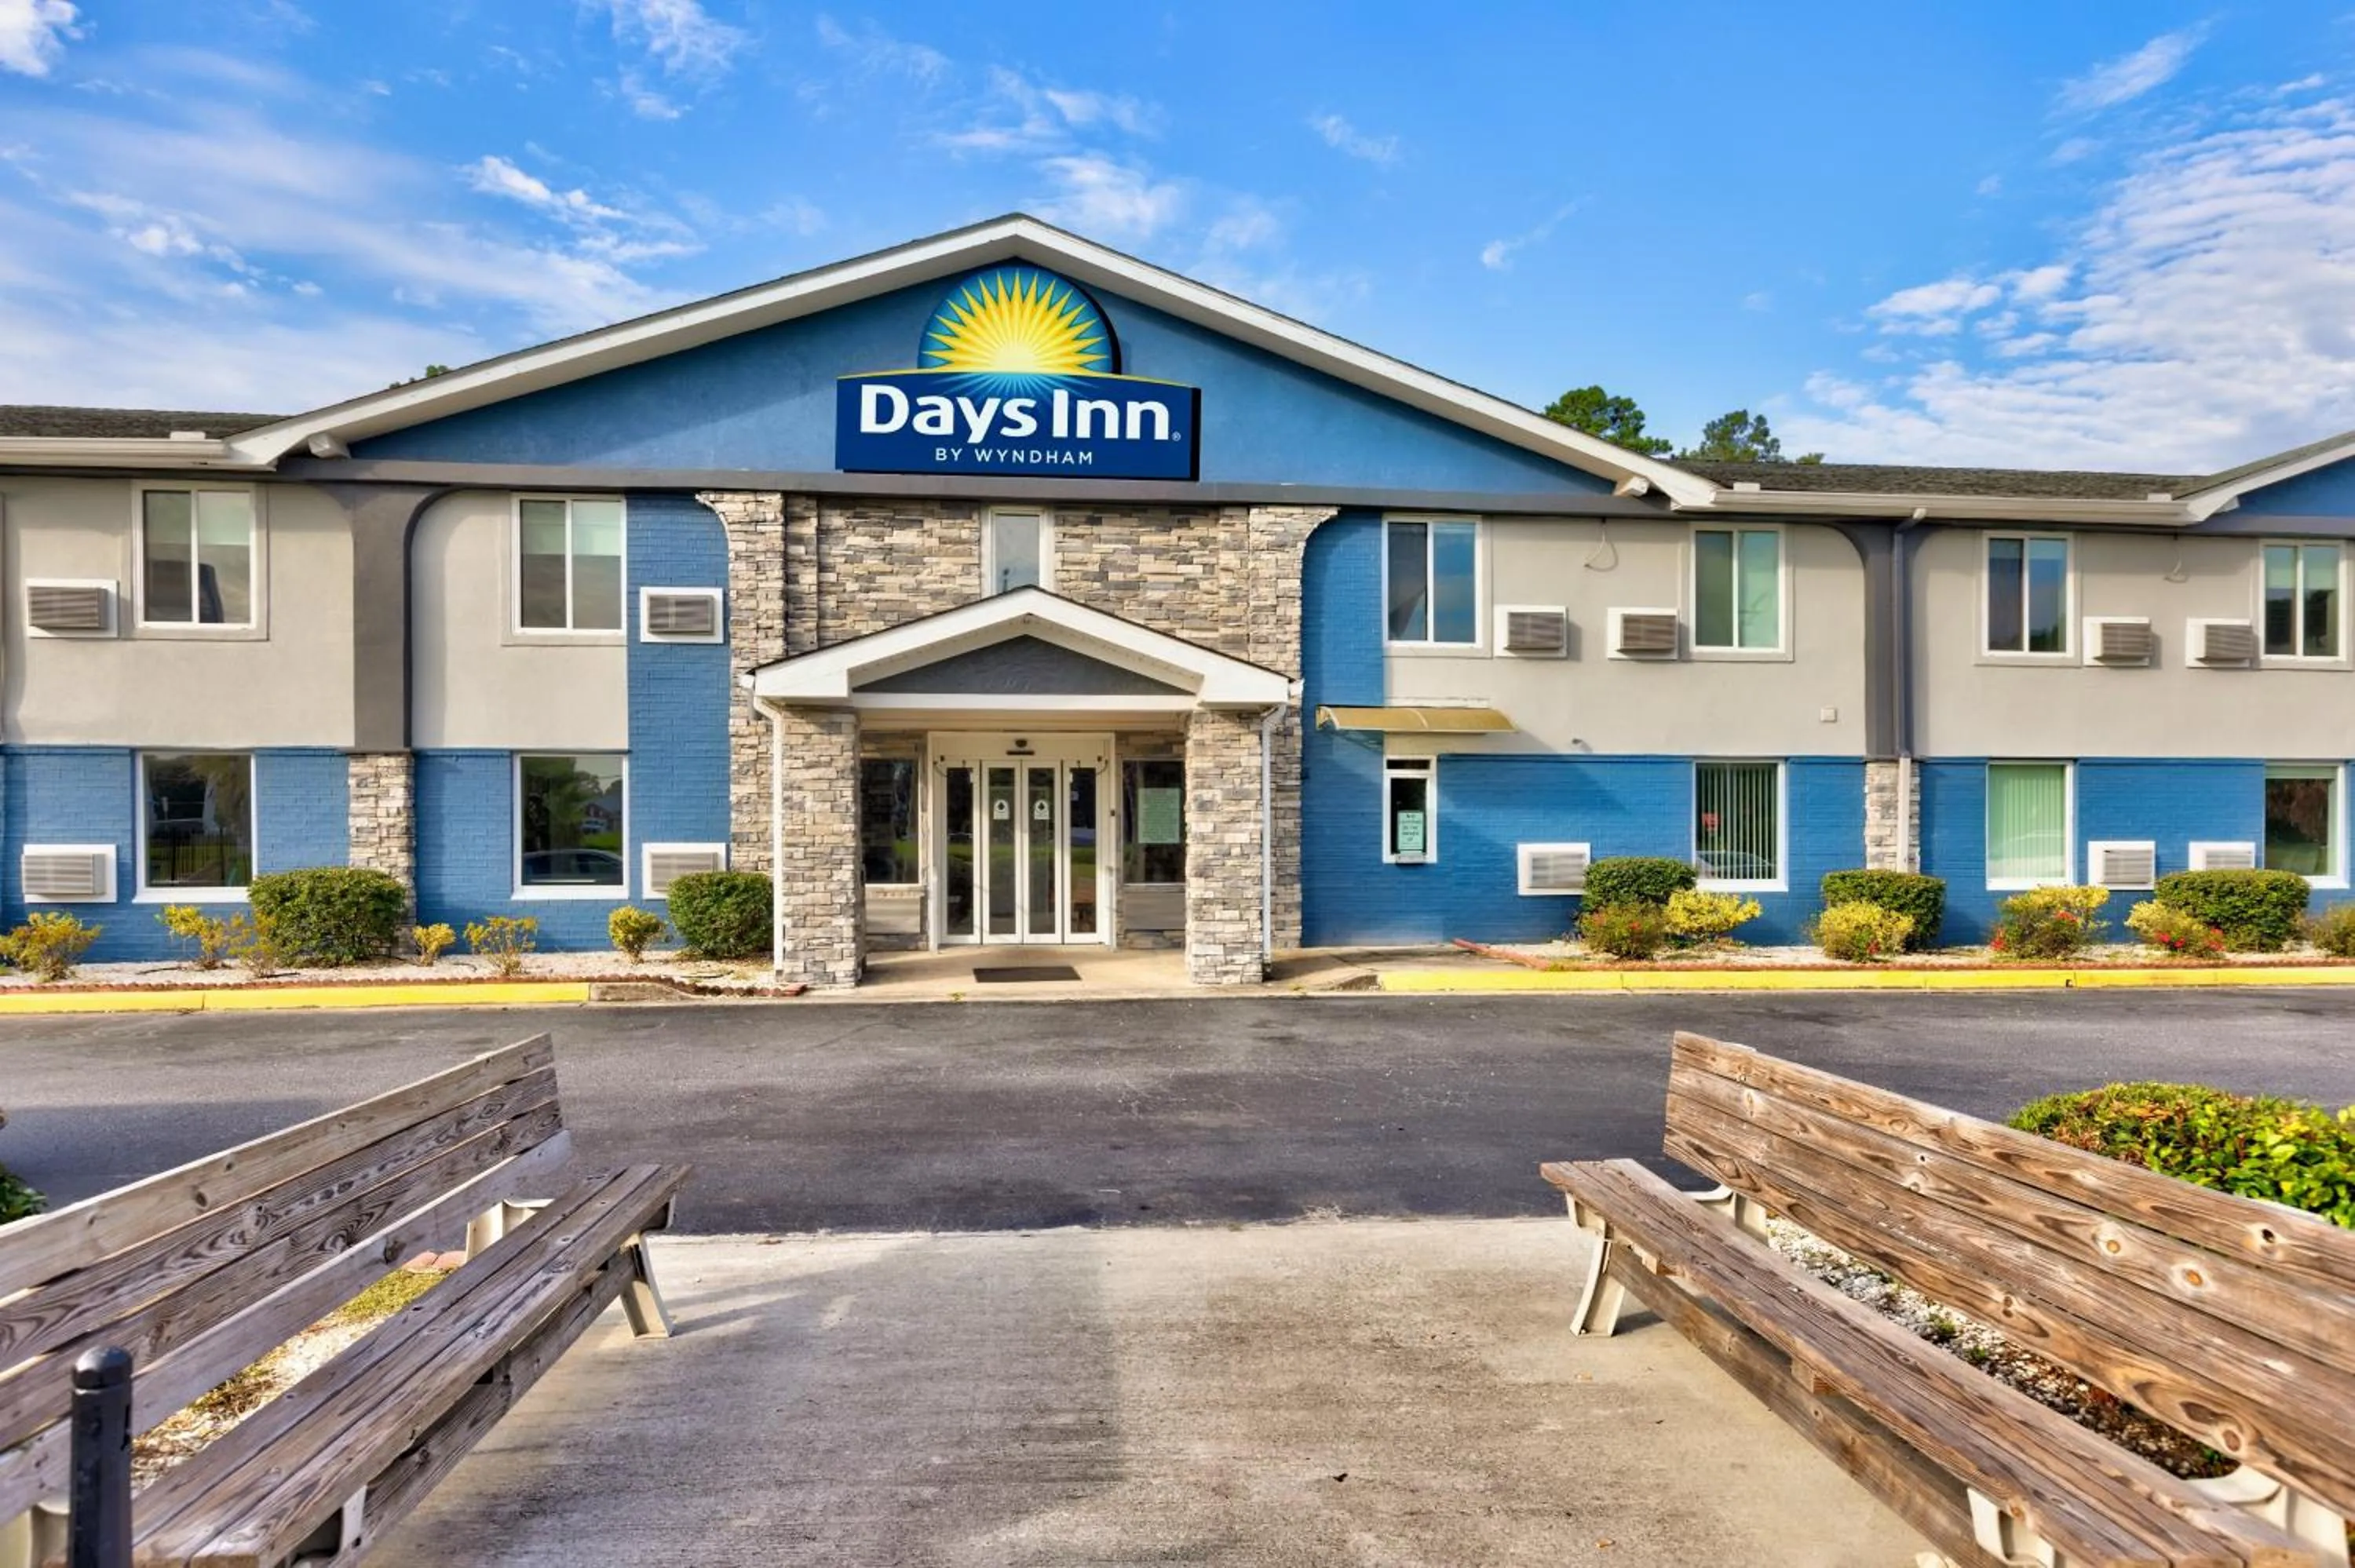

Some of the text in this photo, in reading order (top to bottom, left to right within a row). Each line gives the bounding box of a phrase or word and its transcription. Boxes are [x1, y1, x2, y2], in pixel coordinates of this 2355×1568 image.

[860, 384, 1170, 444] Days Inn
[936, 448, 1092, 465] BY WYNDHAM
